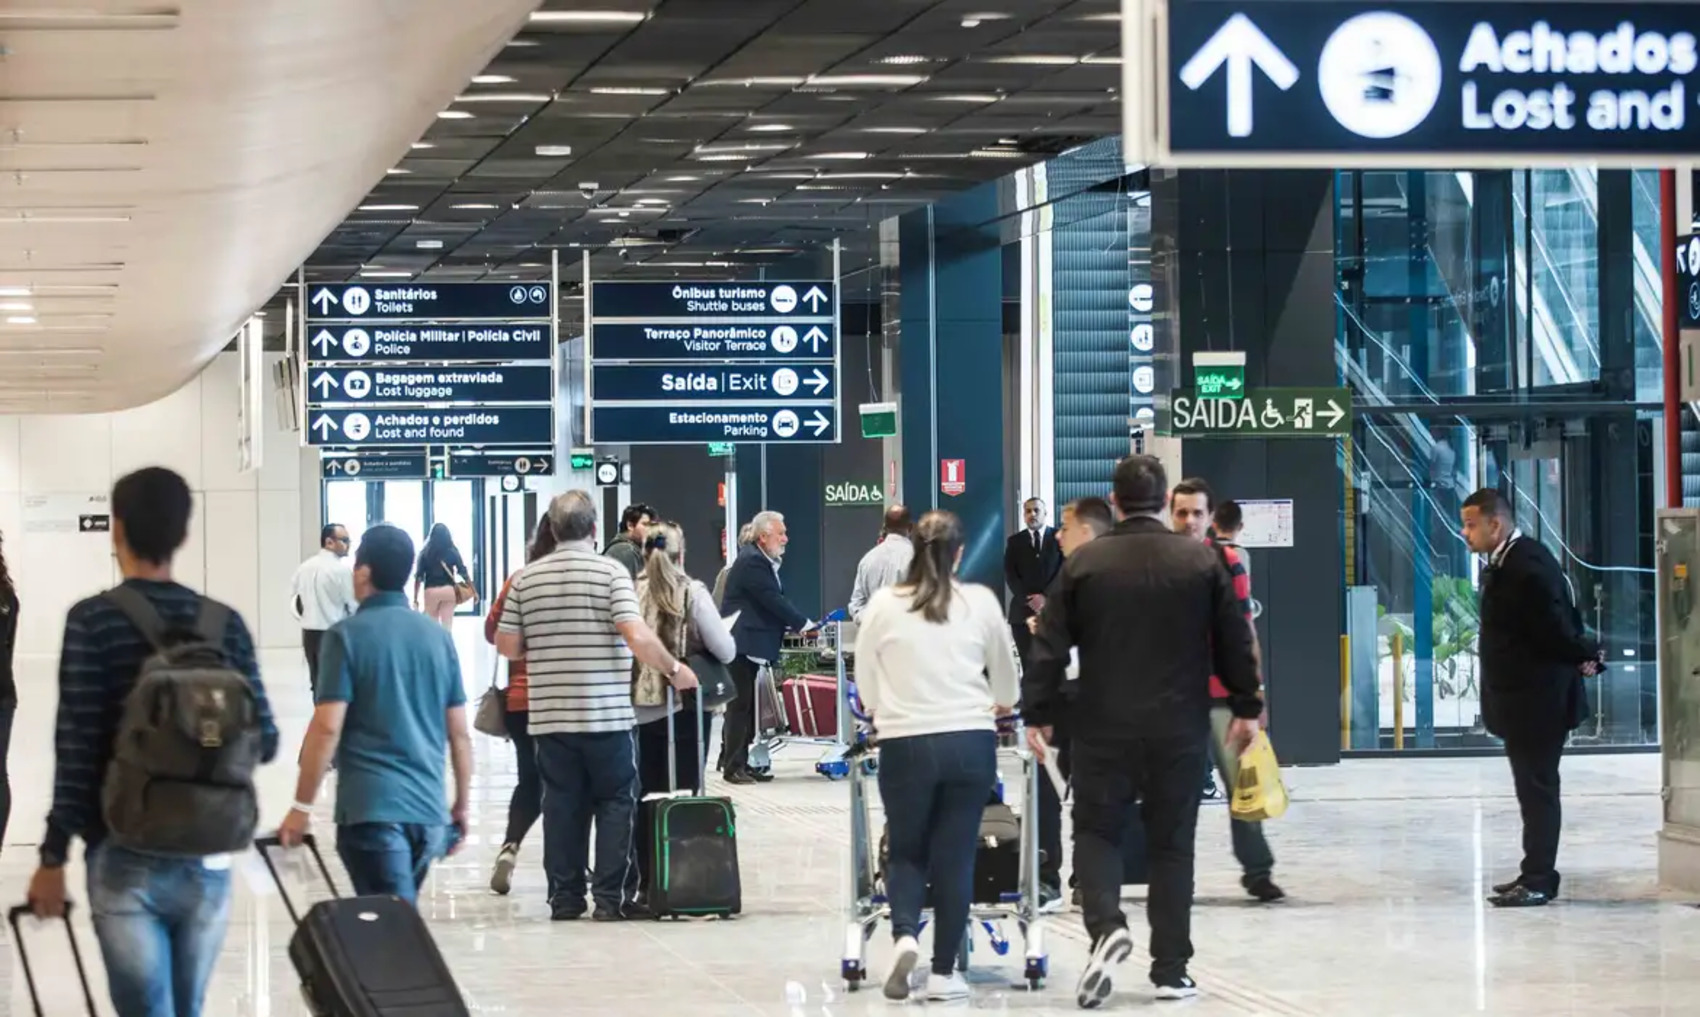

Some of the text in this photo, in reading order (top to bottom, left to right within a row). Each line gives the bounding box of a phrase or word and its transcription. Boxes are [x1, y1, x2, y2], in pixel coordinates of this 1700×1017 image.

[1458, 20, 1698, 75] Achados
[1461, 80, 1686, 131] Lost and
[374, 287, 438, 301] Sanitários
[671, 284, 767, 299] Ônibus turismo
[374, 301, 414, 313] Toilets
[686, 300, 766, 312] Shuttle buses
[374, 329, 541, 343] Polícia Militar Polícia Civil
[643, 326, 767, 340] Terraço Panorâmico
[374, 343, 411, 355] Police
[683, 340, 767, 351] Visitor Terrace
[375, 371, 504, 386] Bagagem extraviada
[661, 373, 767, 391] Saída Exit
[375, 385, 453, 399] Lost luggage
[374, 413, 500, 428] Achados e perdidos
[669, 412, 769, 424] Estacionamento
[375, 427, 465, 439] Lost and found
[723, 424, 768, 438] Parking
[825, 482, 870, 502] SAÍDA
